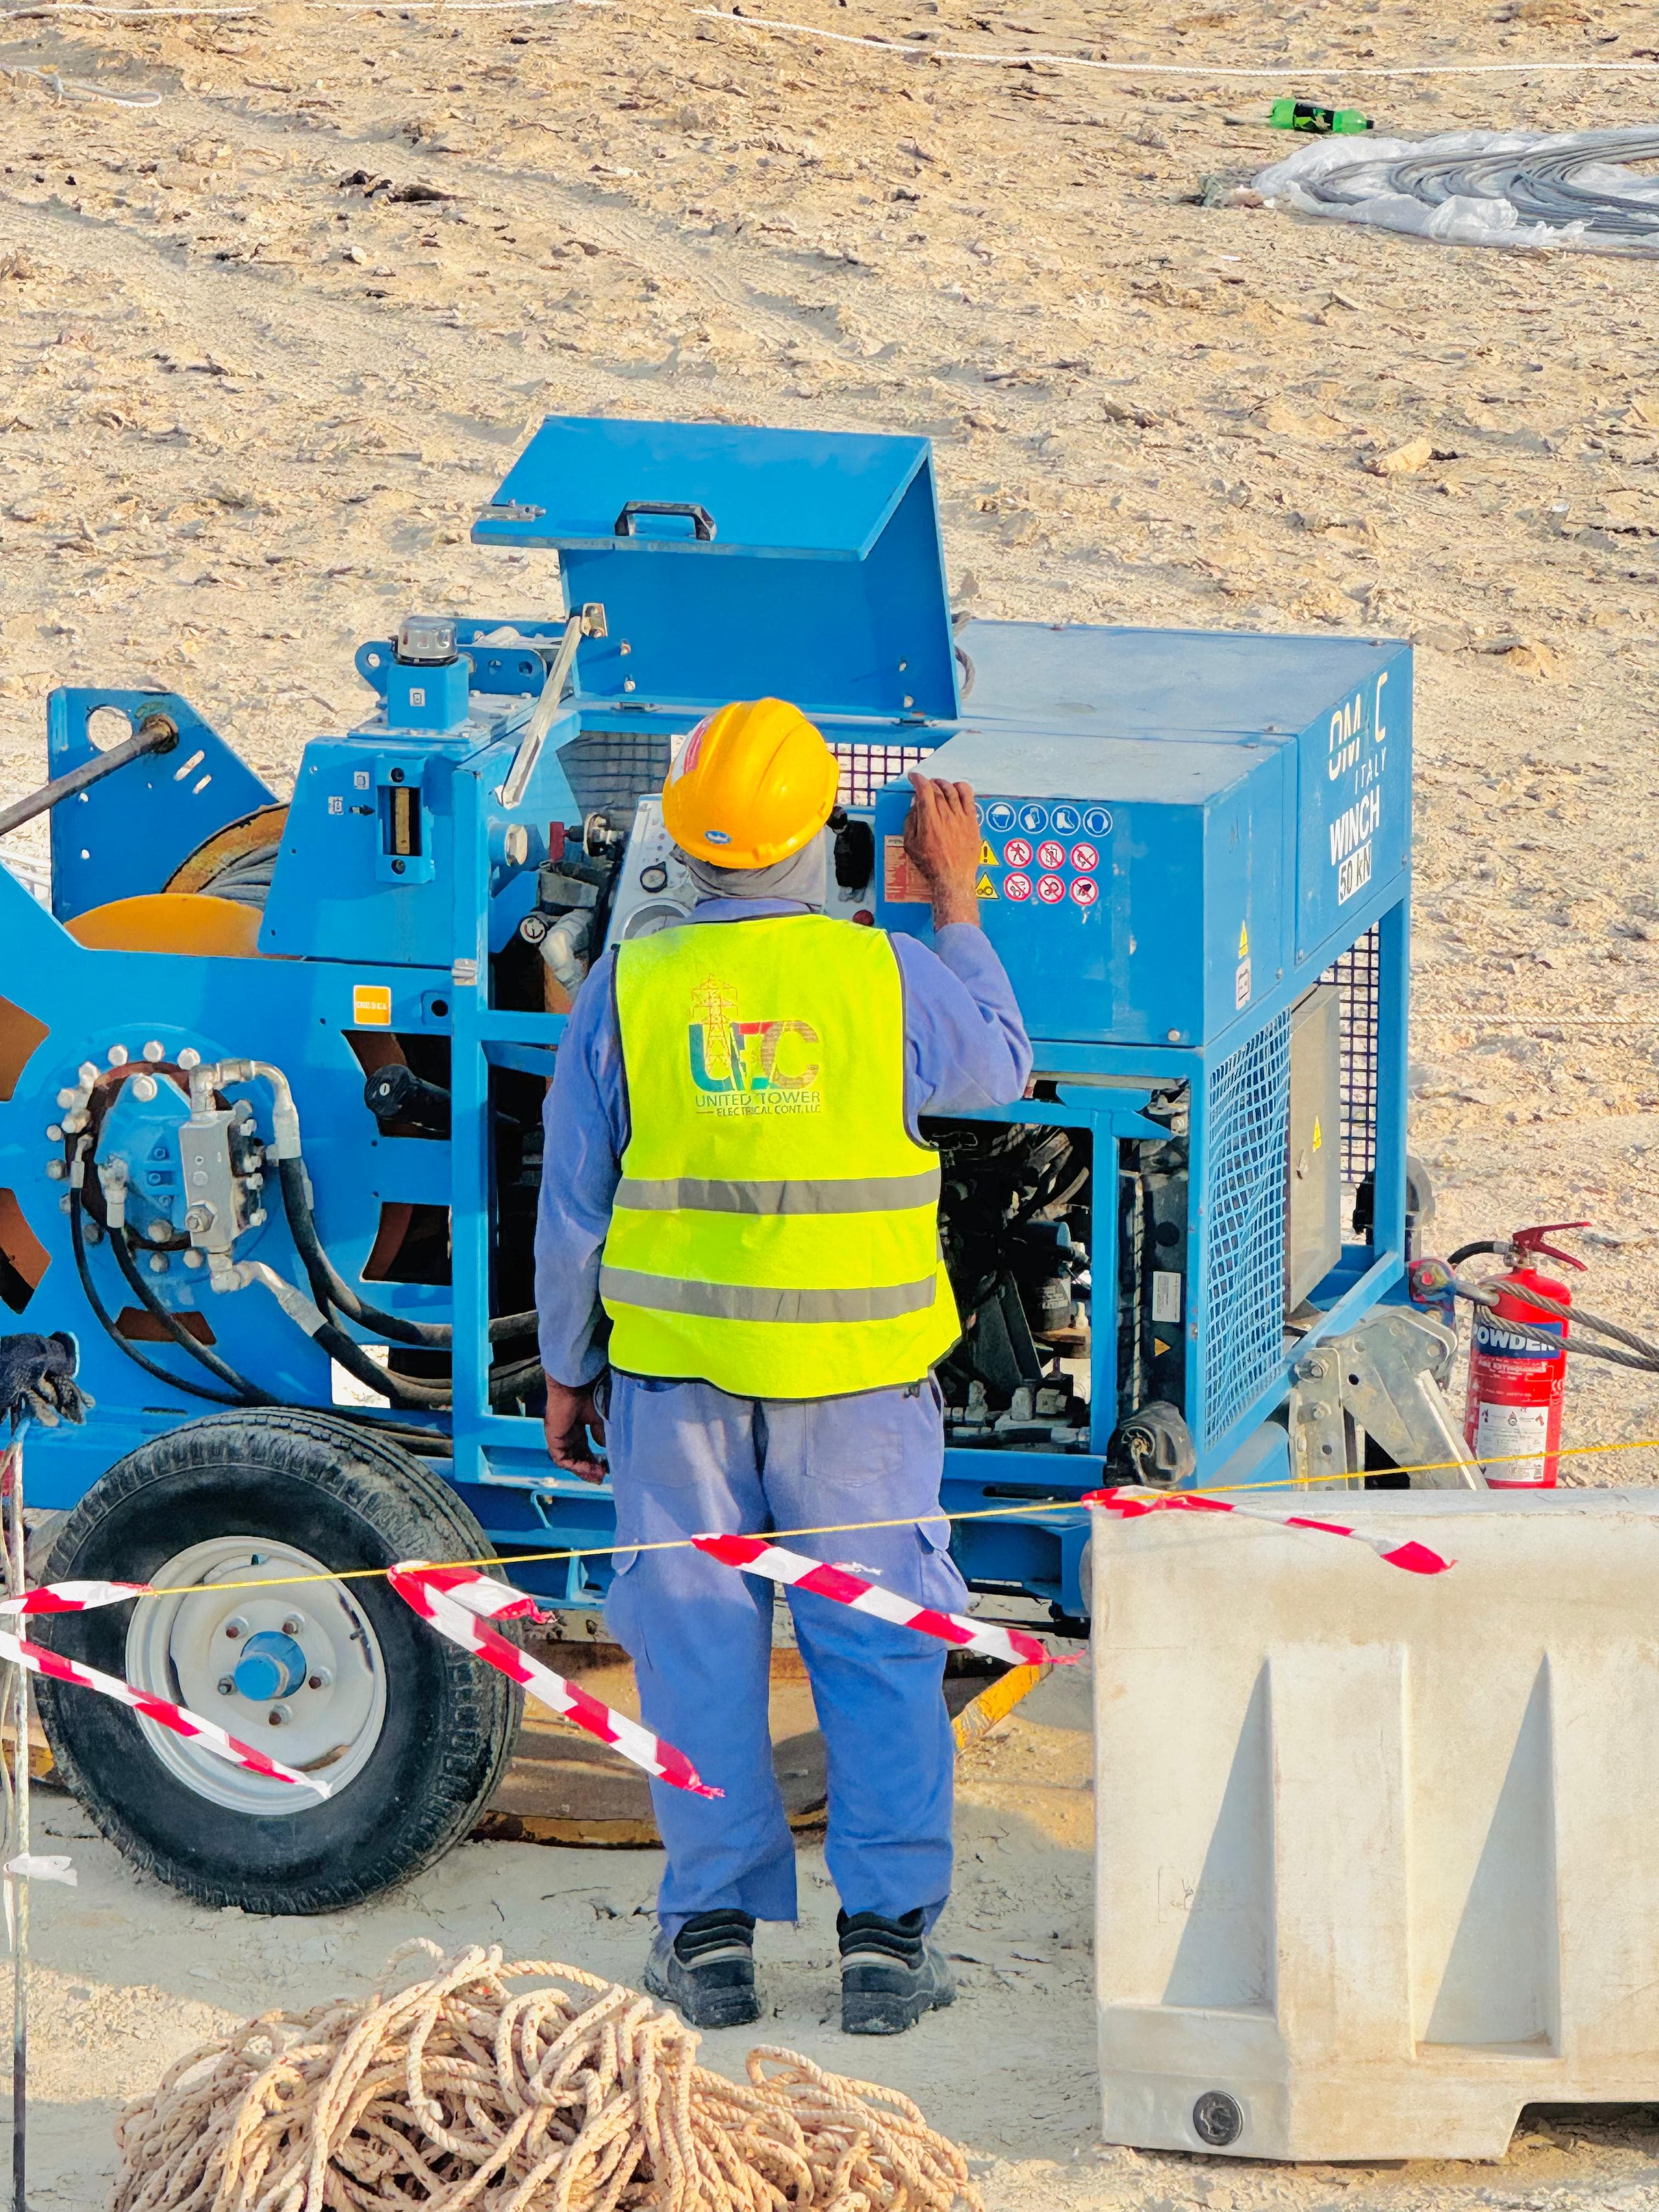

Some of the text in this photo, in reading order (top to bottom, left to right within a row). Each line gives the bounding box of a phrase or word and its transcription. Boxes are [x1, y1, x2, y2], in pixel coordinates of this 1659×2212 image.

[1329, 672, 1388, 781] OMC
[1355, 746, 1386, 794] ITALY
[1330, 785, 1380, 866] WINCH
[1340, 860, 1352, 901] 50
[696, 1092, 820, 1107] UNITED TOWER
[716, 1107, 772, 1116] ELECTRICAL
